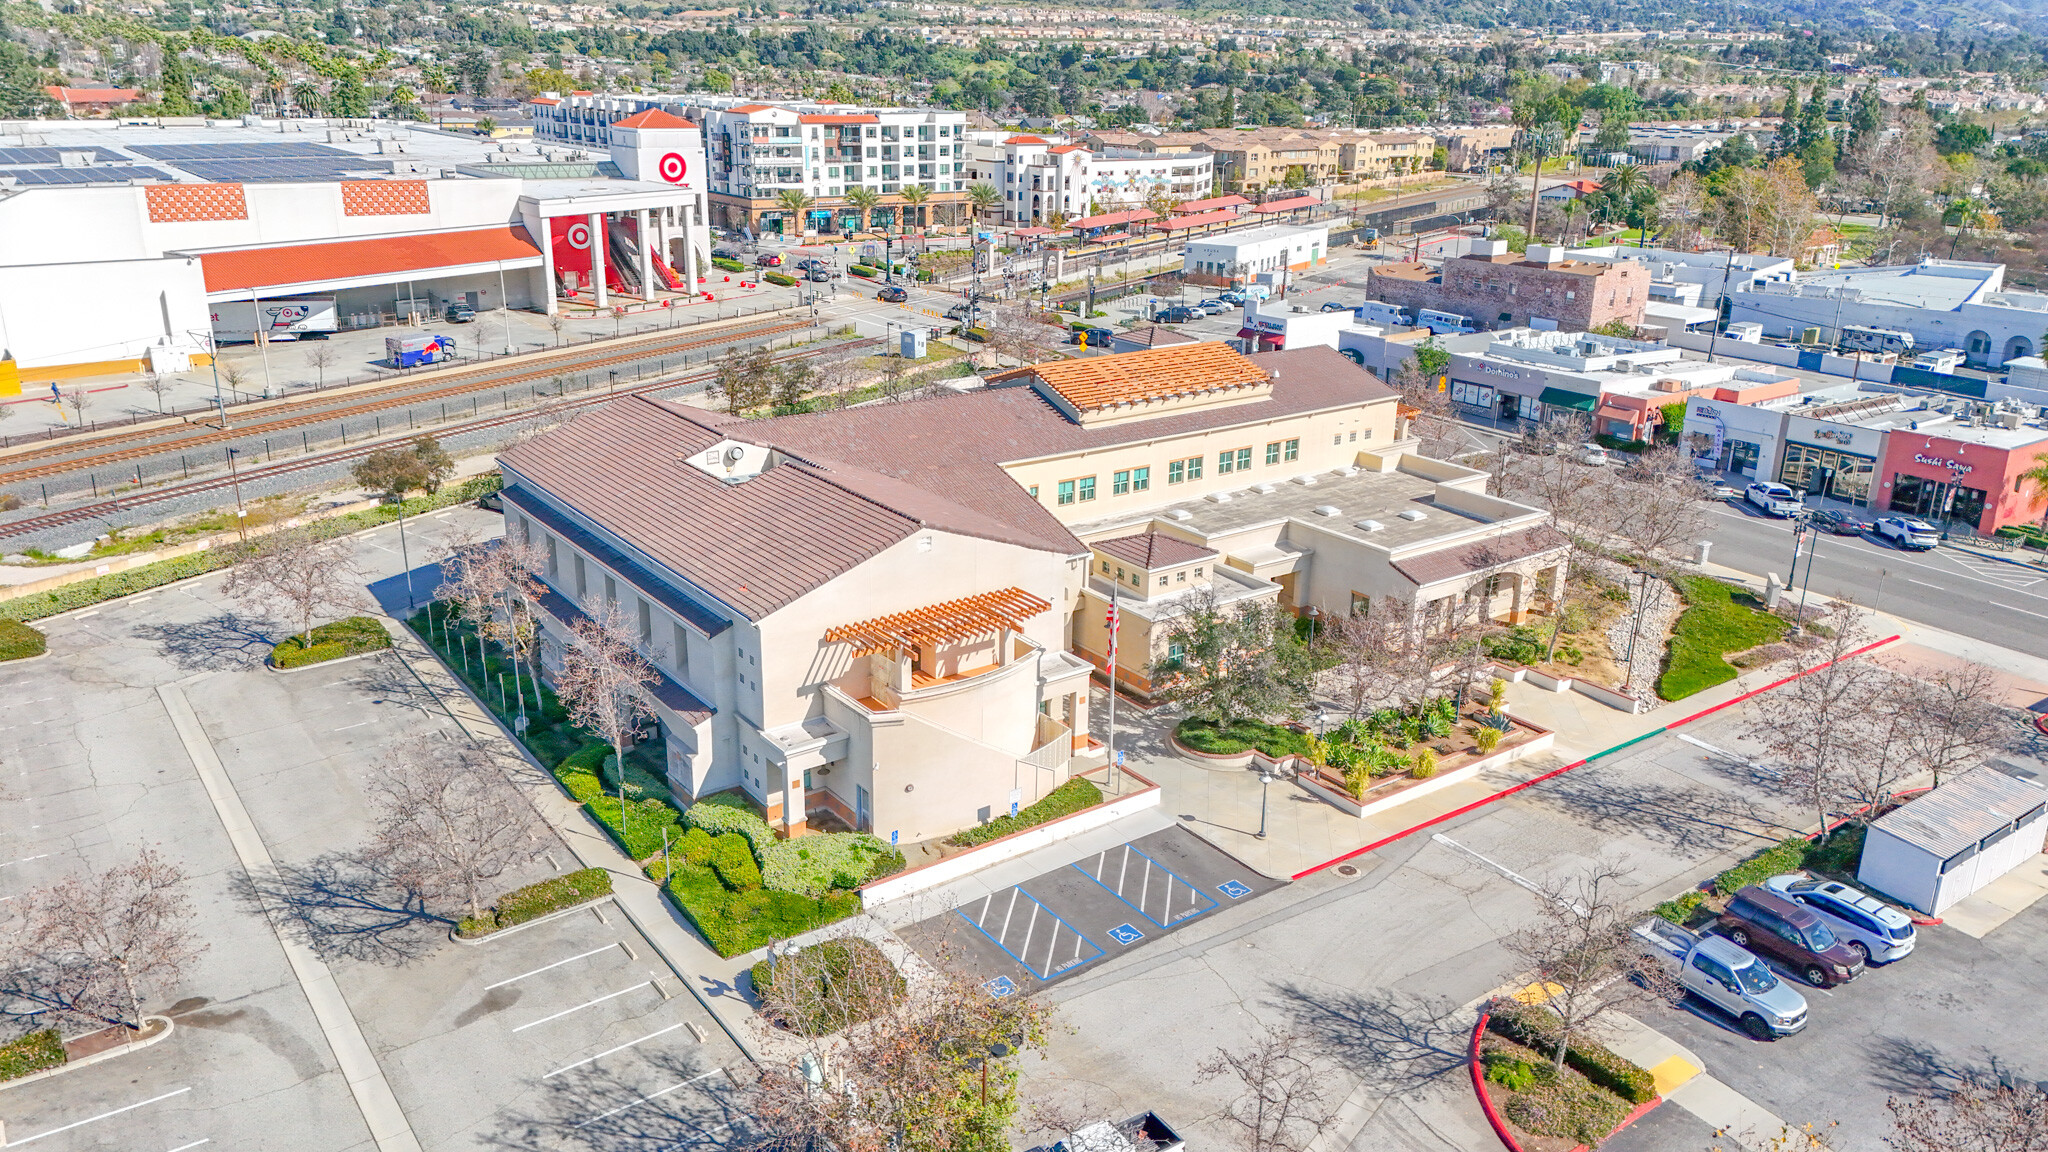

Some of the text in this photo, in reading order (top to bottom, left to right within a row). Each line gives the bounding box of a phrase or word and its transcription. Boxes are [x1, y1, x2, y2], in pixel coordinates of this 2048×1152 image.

[1485, 366, 1520, 380] Domino's
[1914, 453, 1973, 473] Sushi Sawa
[1180, 907, 1201, 918] PARKING
[1061, 957, 1083, 970] PARKING
